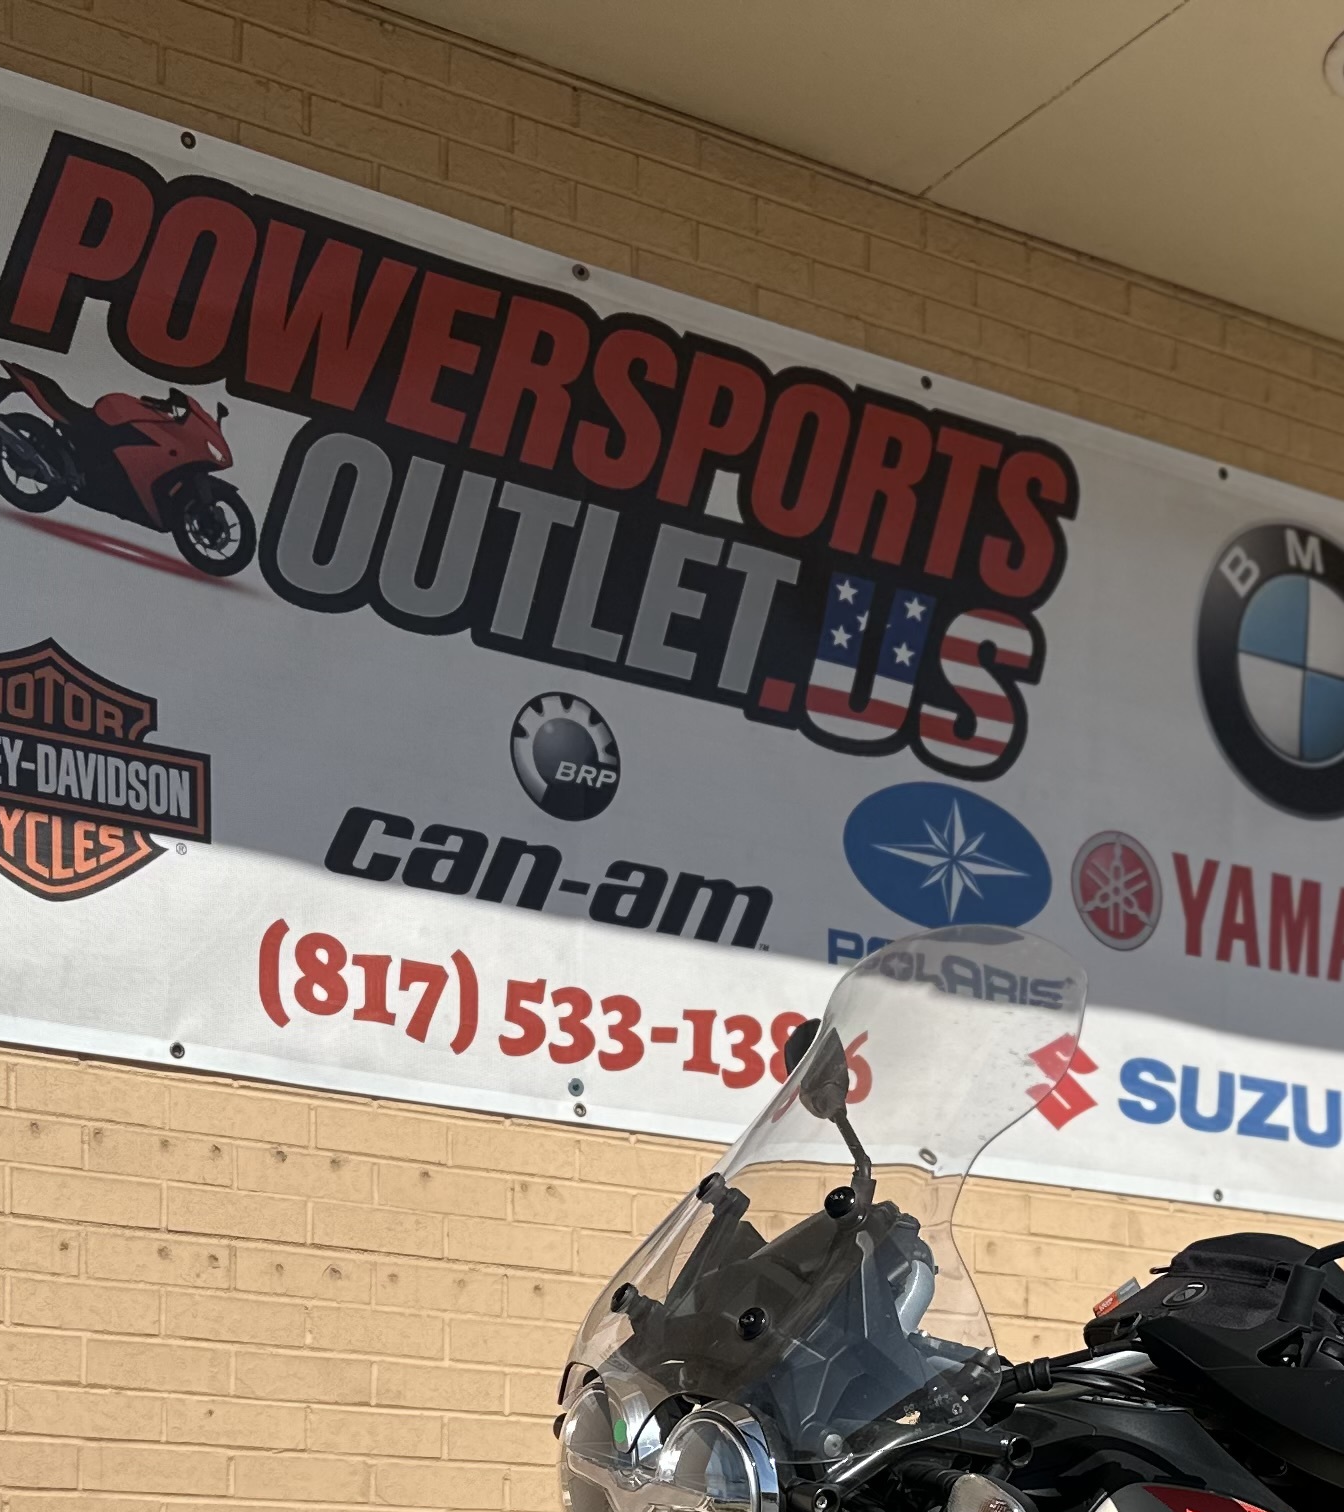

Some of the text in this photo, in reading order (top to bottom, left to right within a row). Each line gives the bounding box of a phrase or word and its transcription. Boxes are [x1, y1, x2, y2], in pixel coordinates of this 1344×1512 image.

[8, 152, 1072, 599] POWERSPORTS
[555, 760, 617, 789] BRP
[324, 806, 774, 951] can-am
[256, 918, 480, 1056] (817)
[827, 927, 1066, 1010] POLARIS
